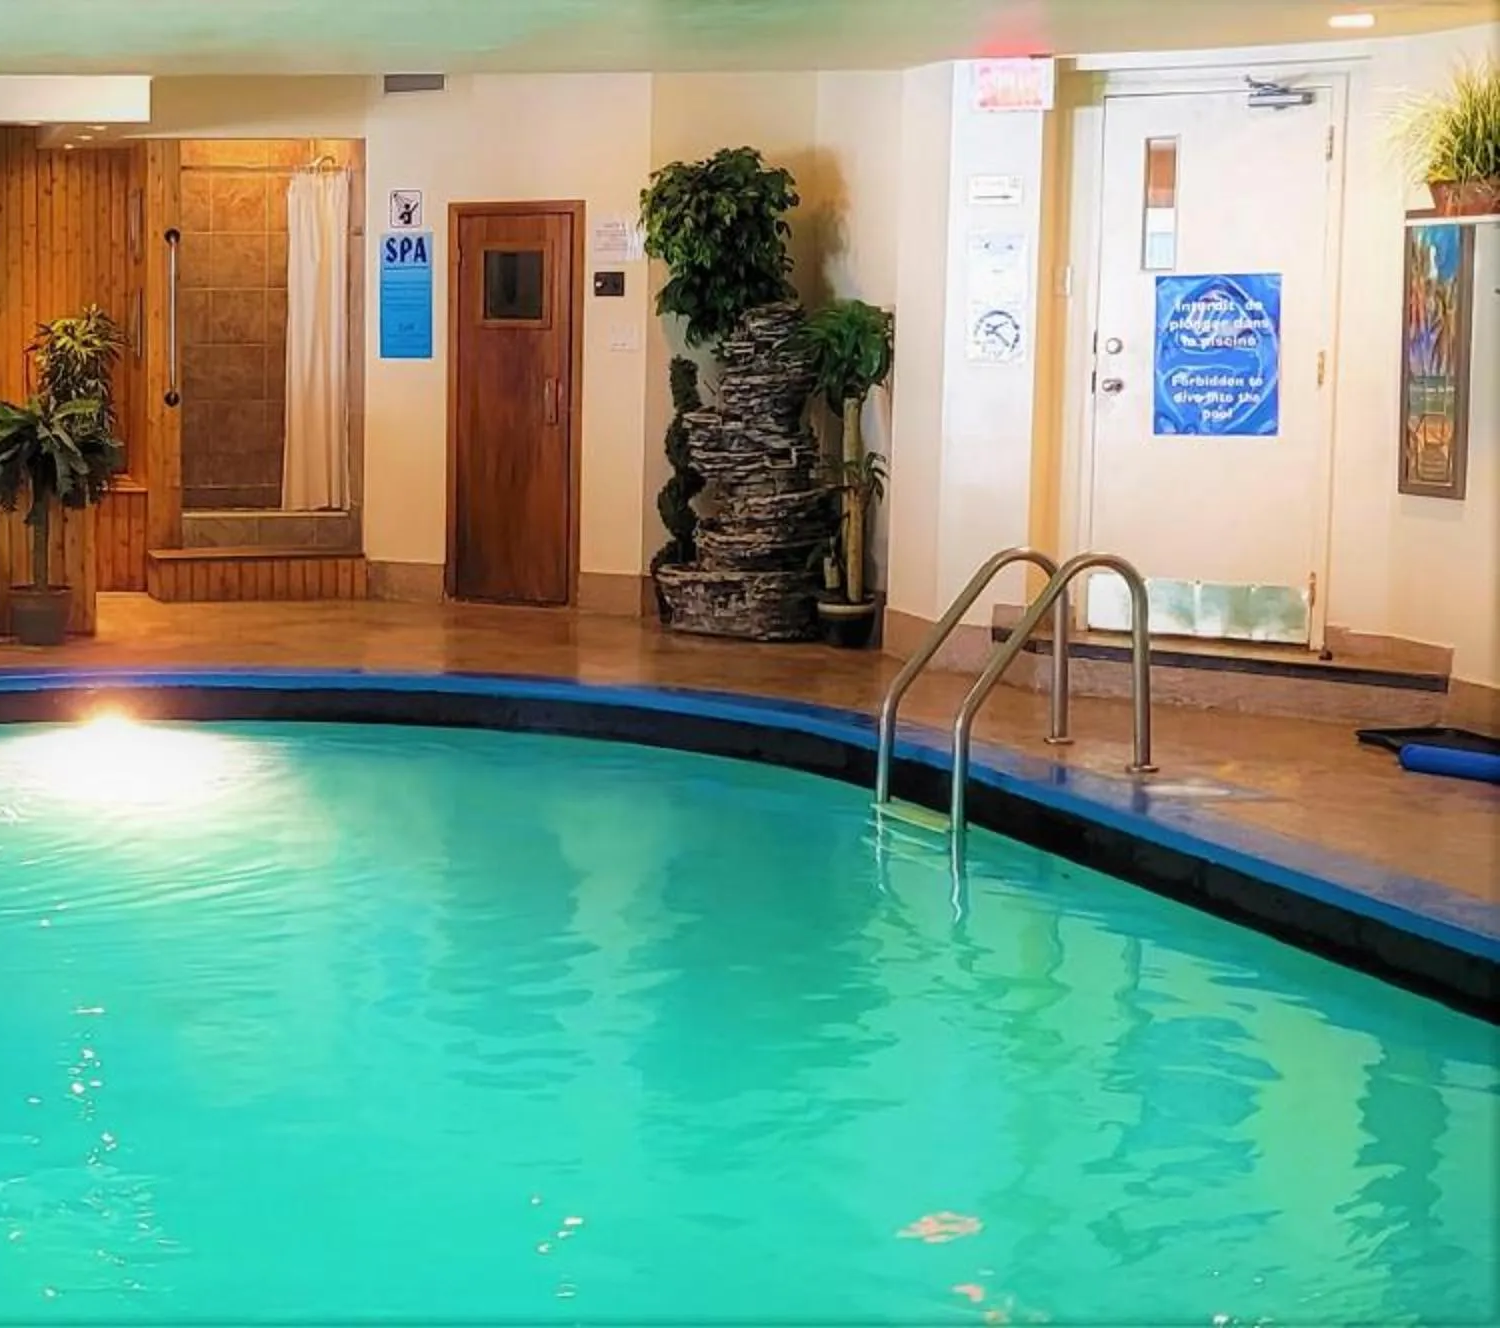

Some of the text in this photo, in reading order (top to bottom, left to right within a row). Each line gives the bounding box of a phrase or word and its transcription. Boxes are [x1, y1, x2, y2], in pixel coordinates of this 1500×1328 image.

[385, 236, 427, 263] SPA
[1245, 300, 1264, 311] de
[1233, 318, 1270, 330] dans
[1201, 336, 1257, 350] piscine
[1171, 375, 1263, 387] Forbidden to
[1173, 391, 1205, 403] dive
[1238, 391, 1262, 403] the
[1202, 407, 1234, 420] pool
